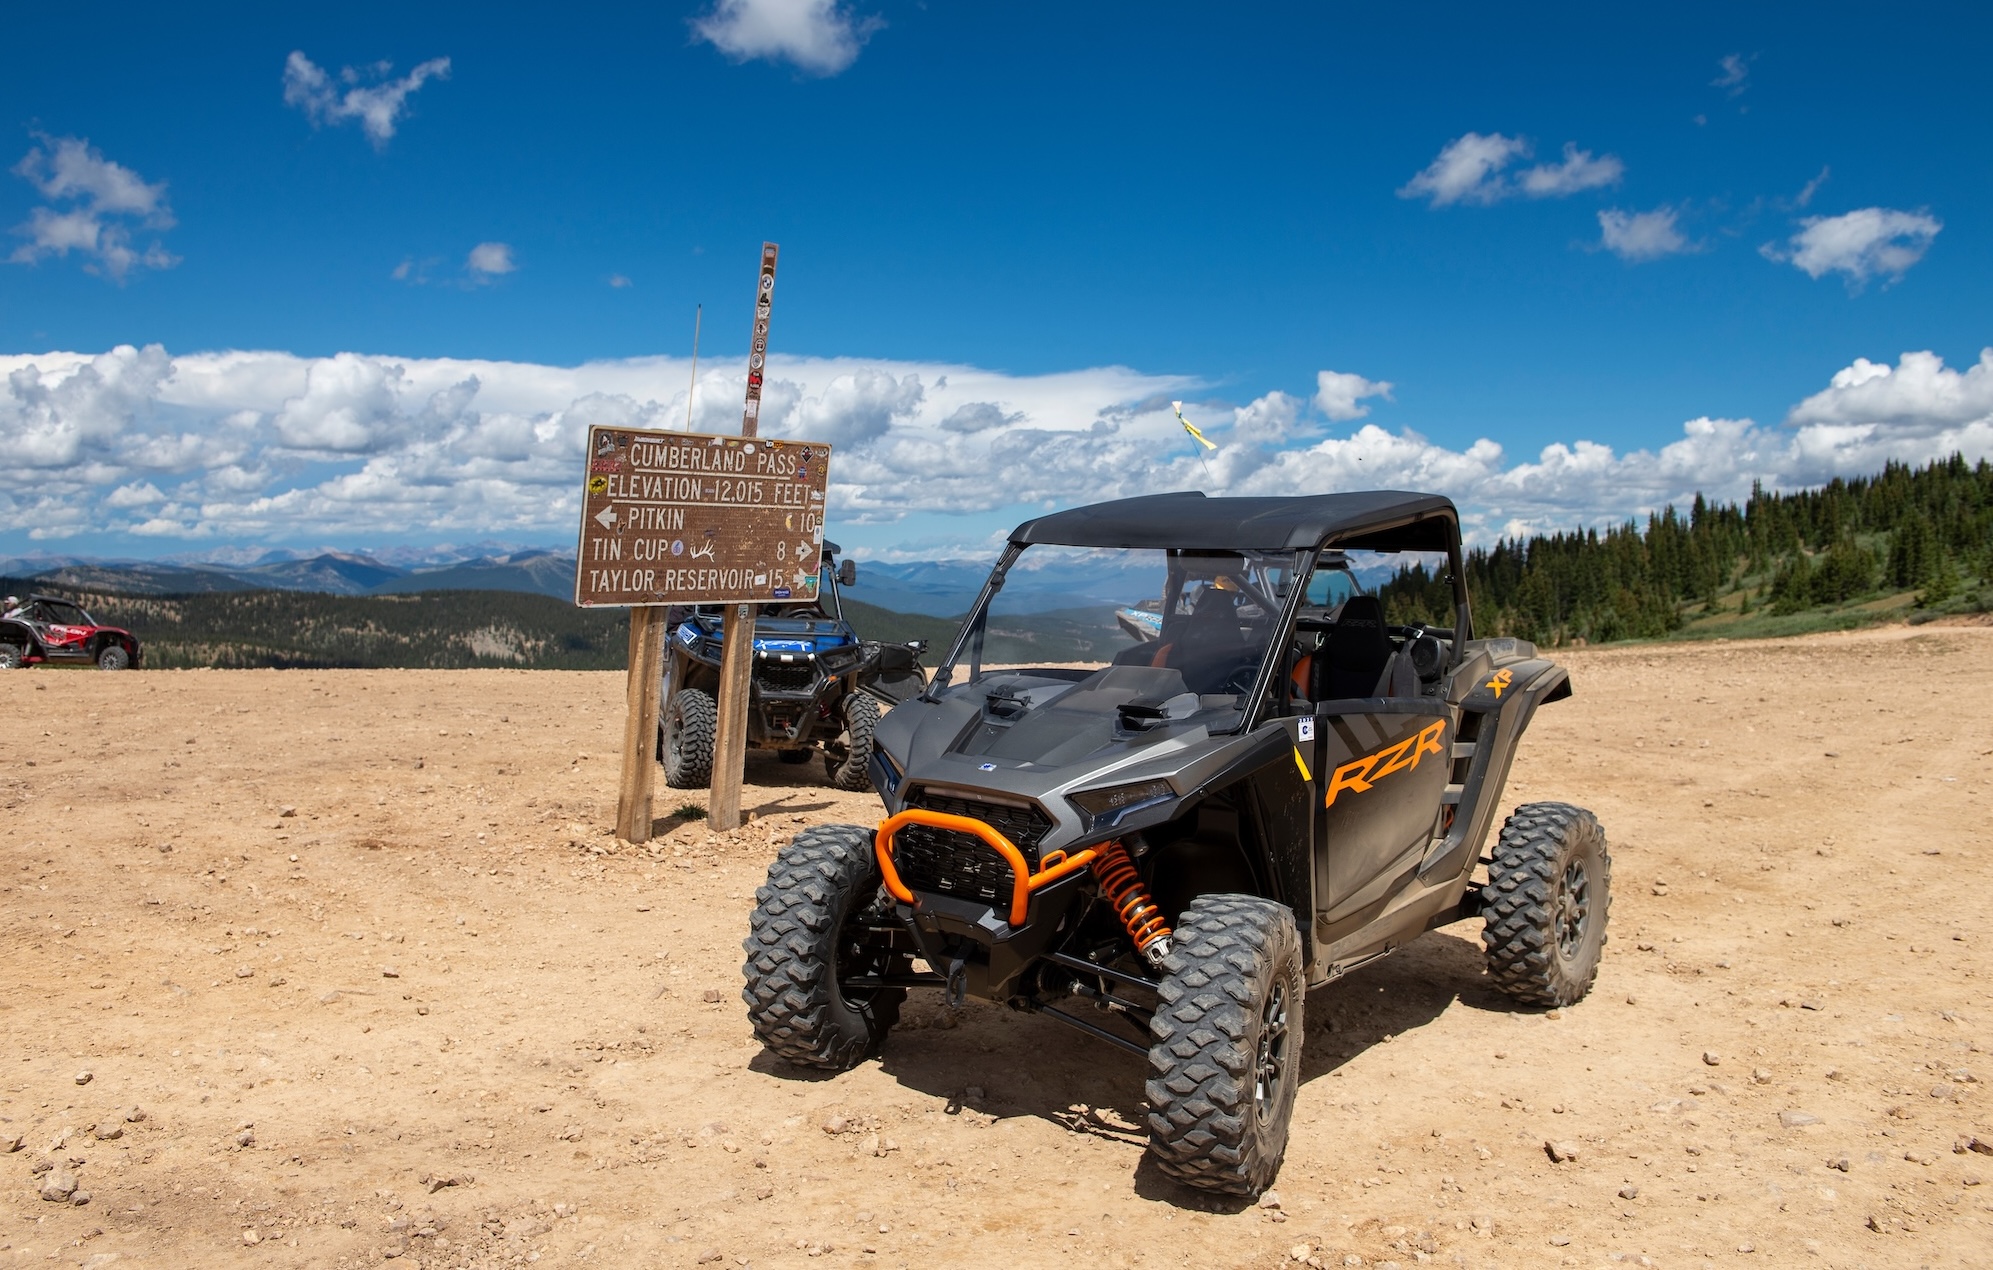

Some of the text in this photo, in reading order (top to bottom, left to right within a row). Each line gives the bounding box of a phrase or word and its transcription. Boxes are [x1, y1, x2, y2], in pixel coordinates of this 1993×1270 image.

[630, 443, 746, 472] CUMBERLAND
[757, 452, 796, 475] PASS
[607, 474, 812, 505] ELEVATION 12,015 FEET
[628, 507, 815, 533] PITKIN 10
[593, 538, 786, 561] TIN CUP 8
[590, 568, 784, 592] TAYLOR RESERVOIR 15
[1485, 668, 1514, 699] XP
[1325, 718, 1447, 809] RZR
